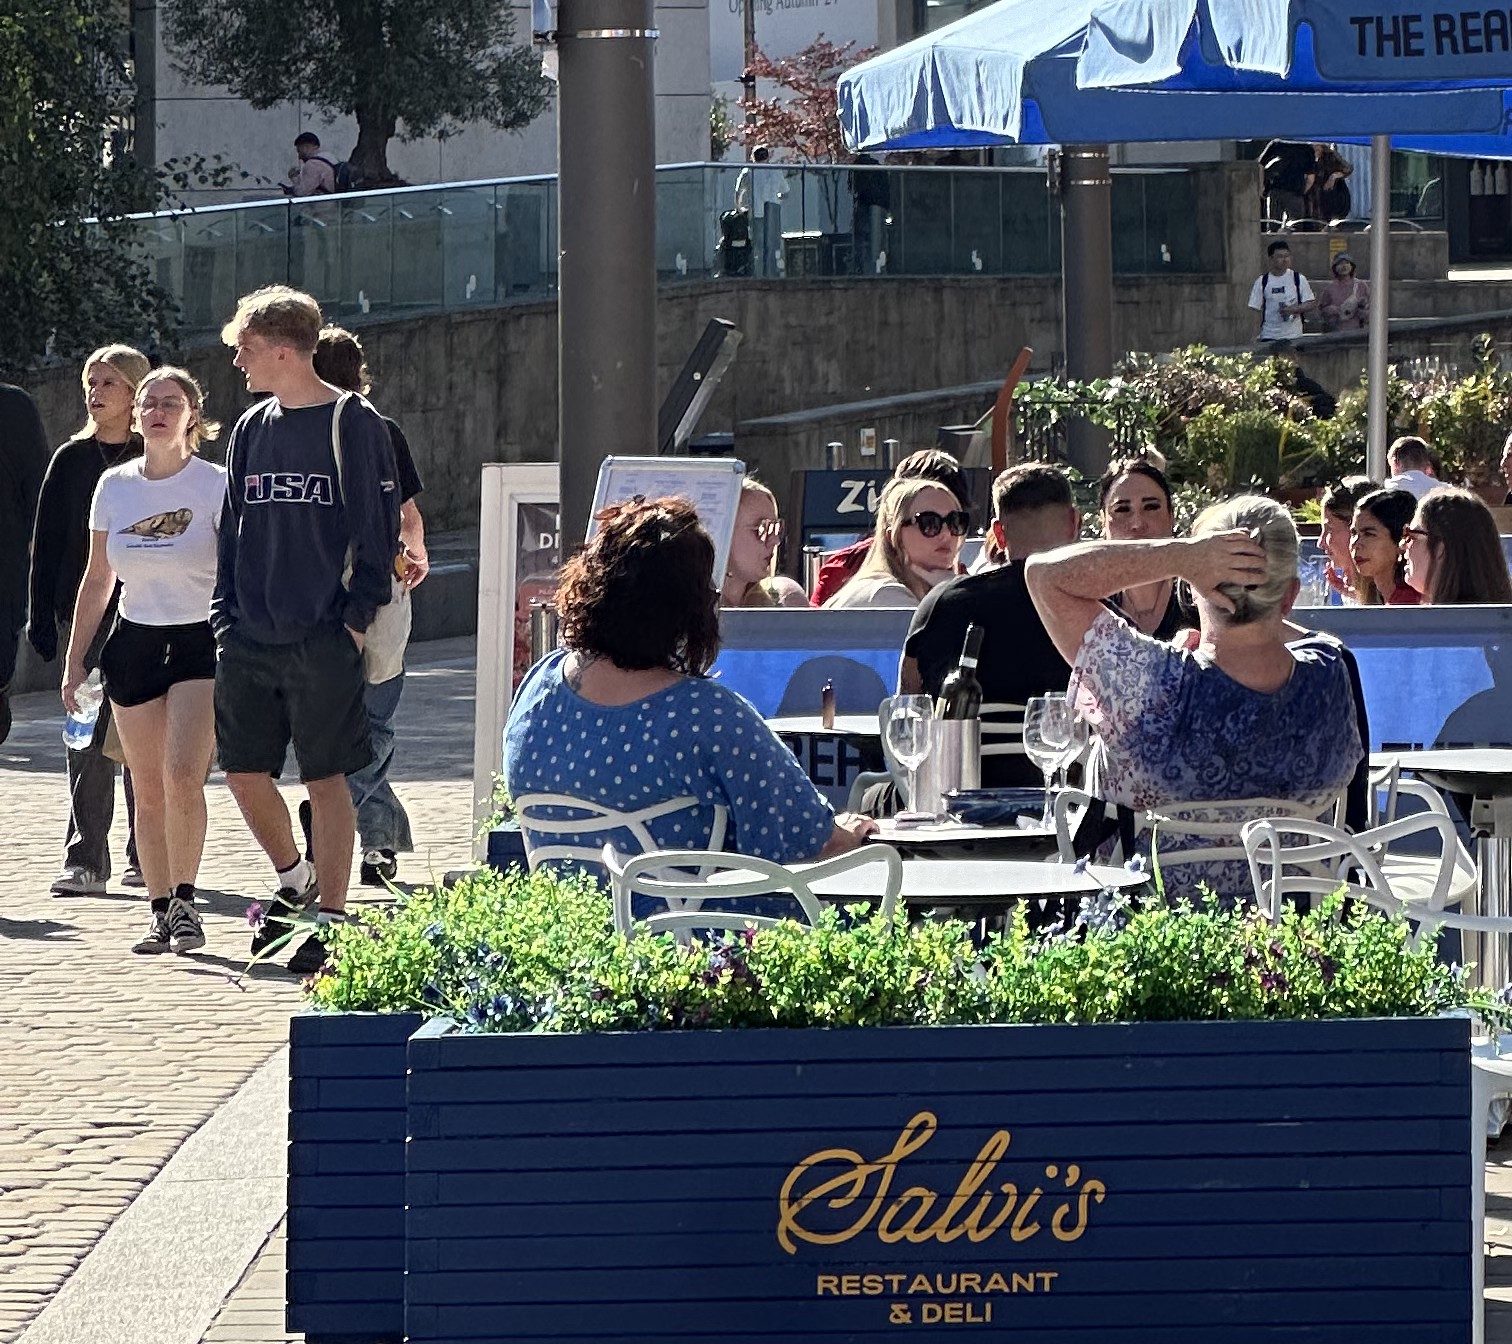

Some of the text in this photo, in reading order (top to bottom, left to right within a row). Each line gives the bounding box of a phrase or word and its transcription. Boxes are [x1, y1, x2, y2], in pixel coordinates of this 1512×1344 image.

[1350, 15, 1426, 58] THE
[244, 472, 333, 505] USA
[776, 1110, 1106, 1256] Salvi's
[817, 1271, 1059, 1296] RESTAURANT
[888, 1302, 993, 1325] & DELI
